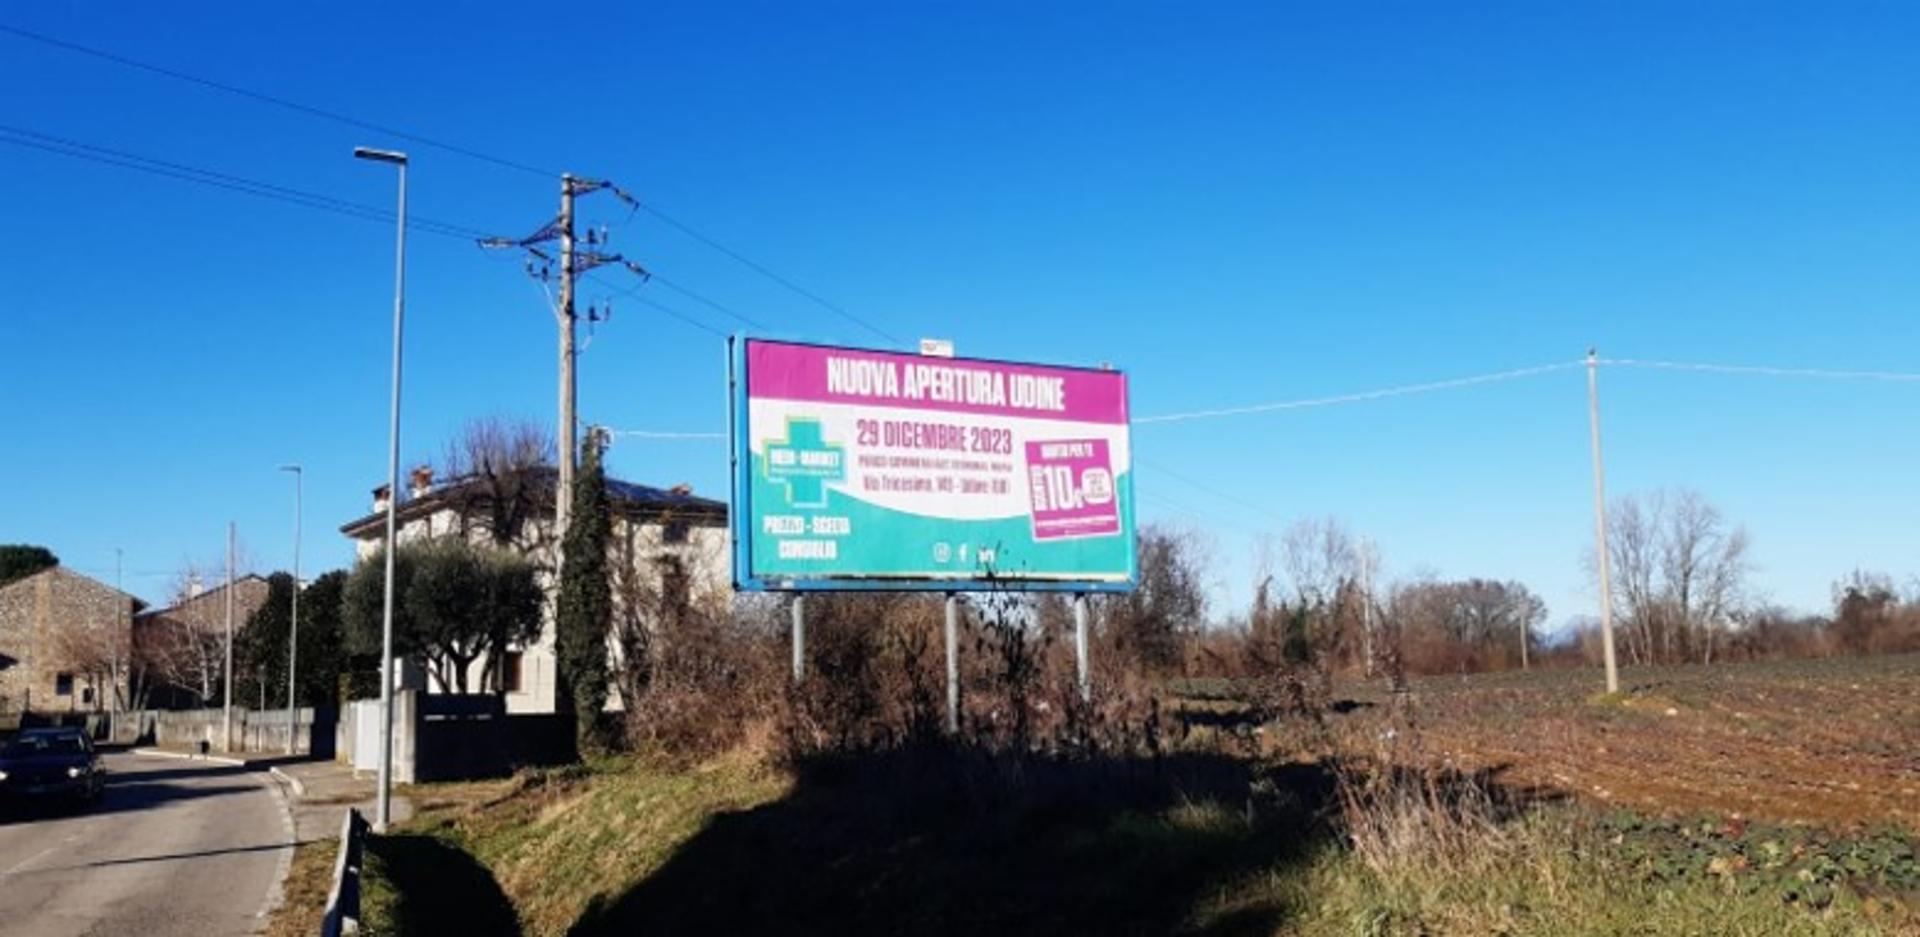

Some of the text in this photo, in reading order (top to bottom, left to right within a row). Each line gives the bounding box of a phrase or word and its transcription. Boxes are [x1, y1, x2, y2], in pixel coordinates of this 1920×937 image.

[827, 357, 1065, 411] NUOVA APERTURA UDINE
[857, 419, 1013, 454] 29 DICEMBRE 2023
[863, 475, 880, 492] Via
